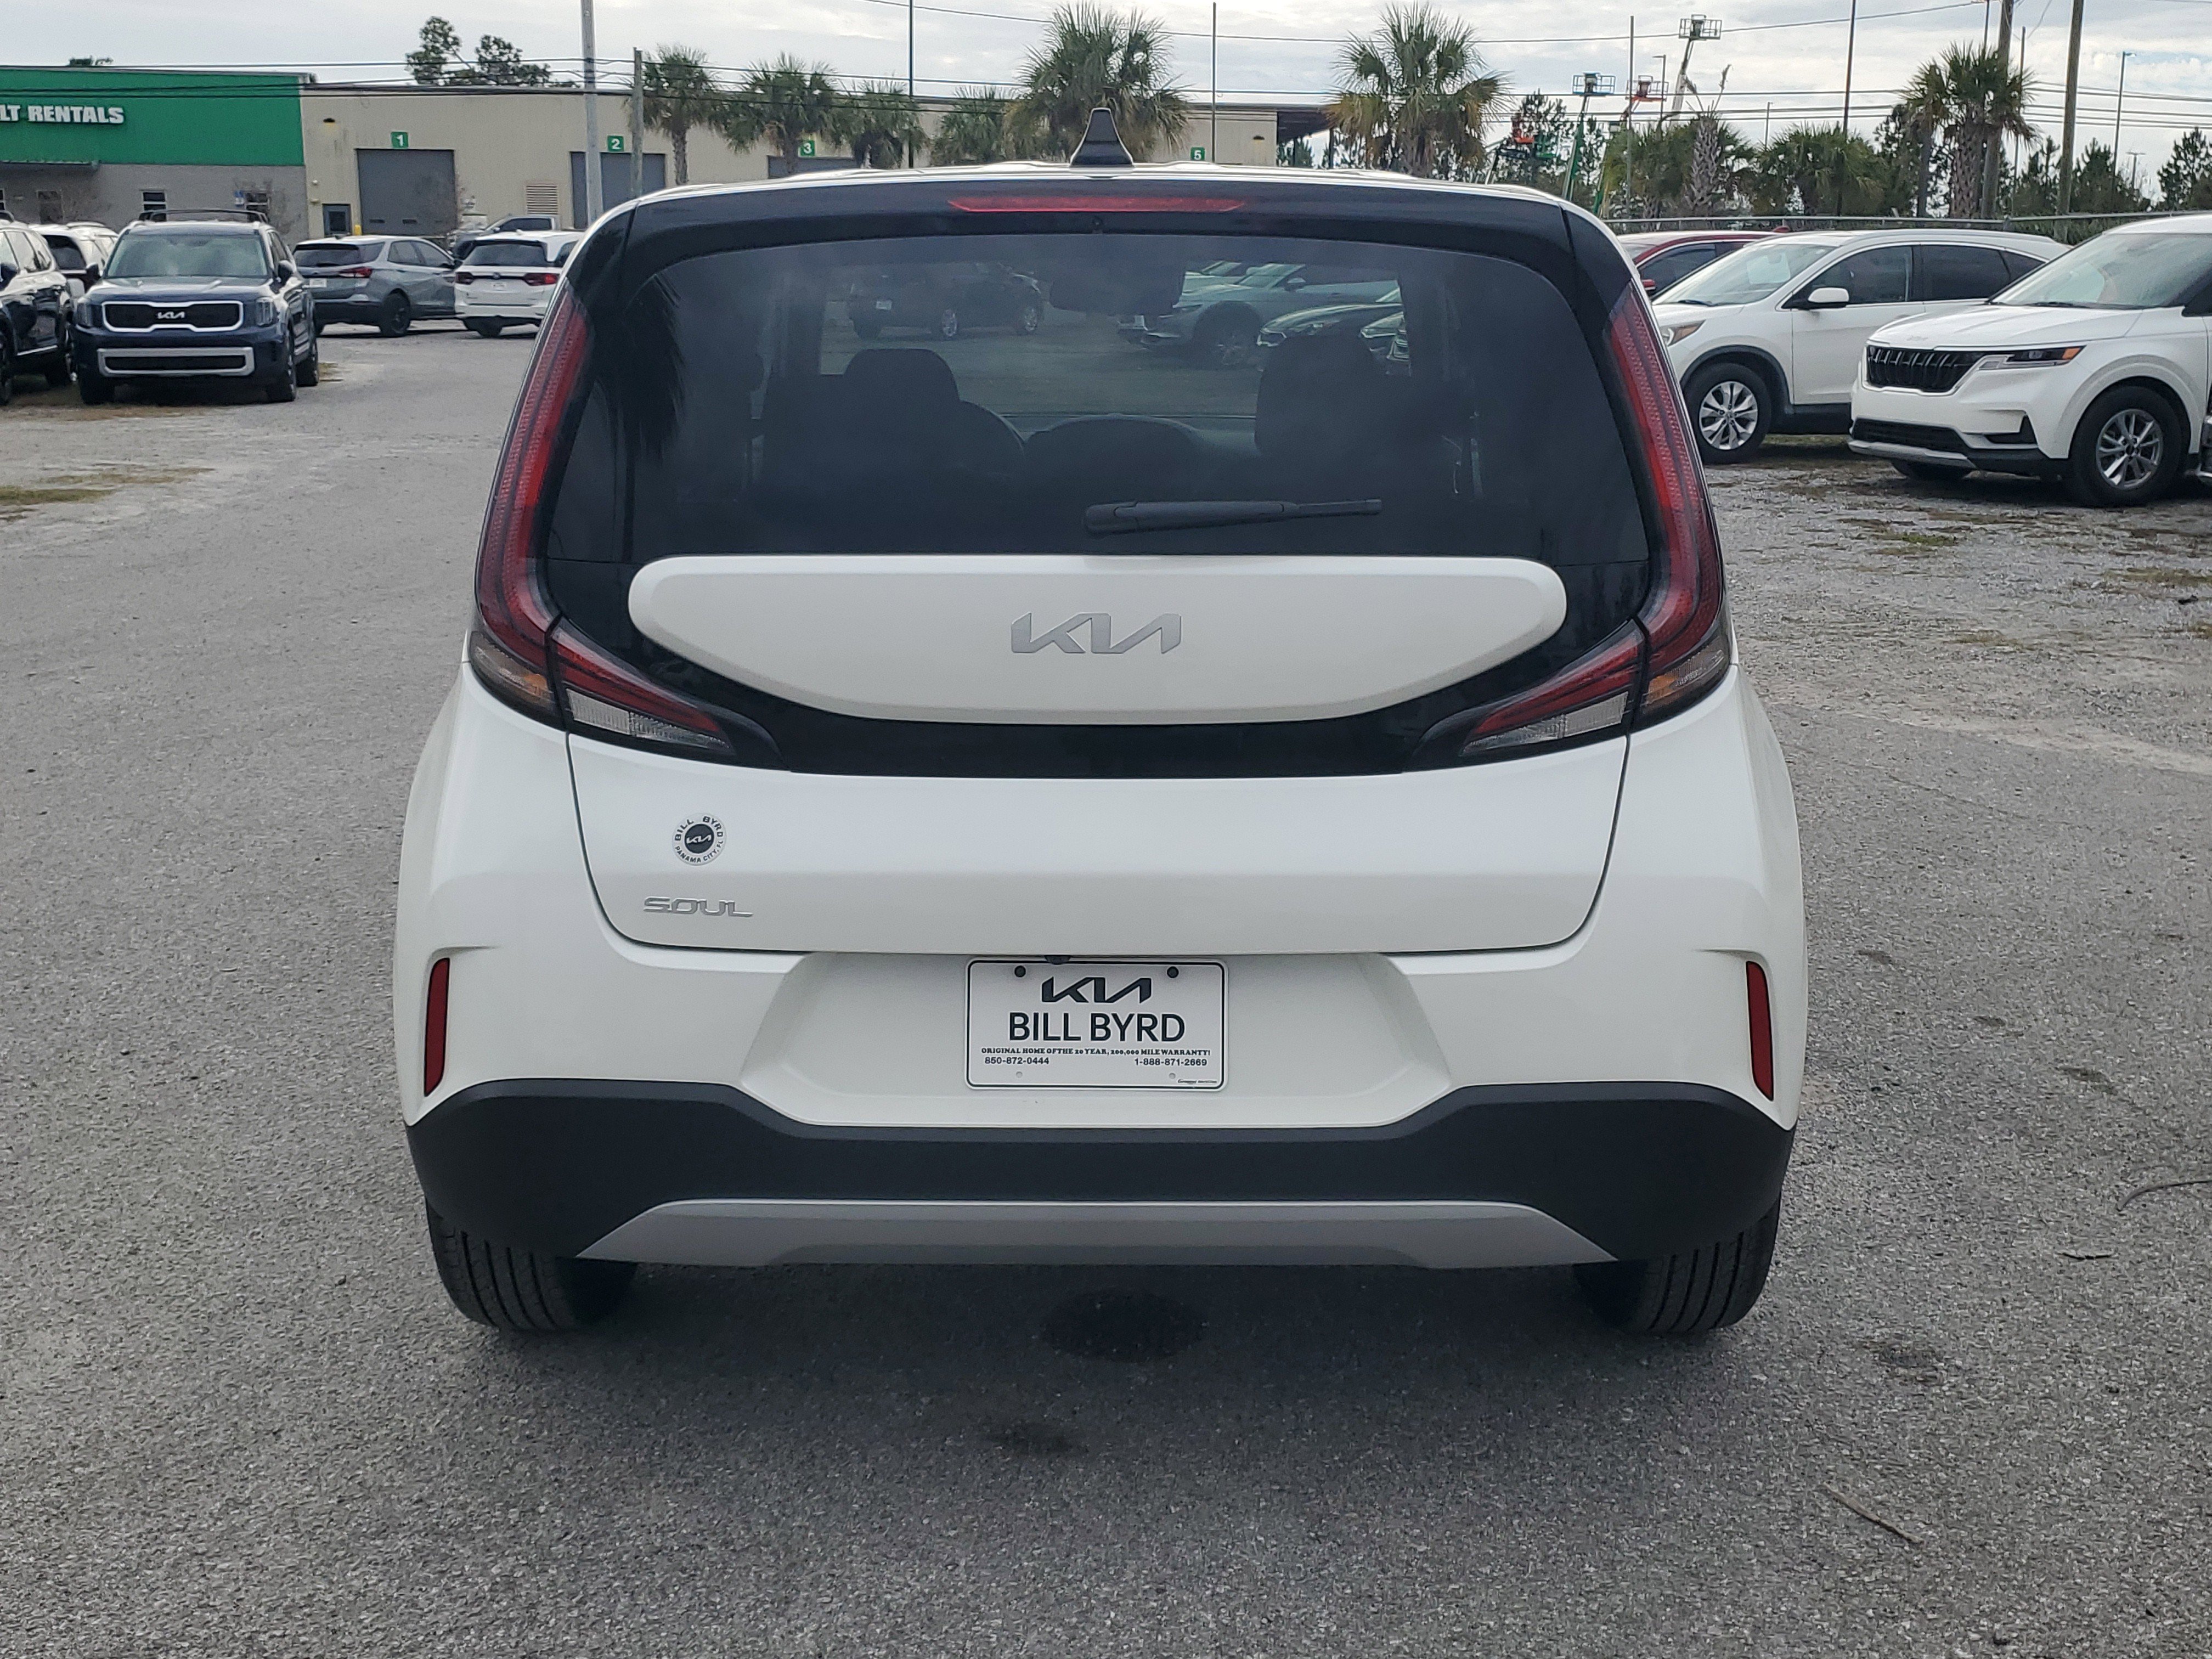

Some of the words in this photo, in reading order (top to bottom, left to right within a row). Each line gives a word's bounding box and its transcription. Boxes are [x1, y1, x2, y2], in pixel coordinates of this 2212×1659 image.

[28, 105, 124, 124] RENTALS
[396, 134, 404, 146] 1
[611, 138, 621, 149] 2
[803, 143, 812, 154] 3
[1194, 150, 1201, 160] 5
[1011, 612, 1181, 654] KIA
[675, 819, 694, 840] BILL
[702, 816, 723, 837] BYRD
[686, 834, 712, 844] KIA
[675, 846, 701, 862] PANAMA
[643, 896, 754, 917] SOUL
[1042, 977, 1151, 1003] KIA
[1009, 1012, 1081, 1041] BILL
[1091, 1013, 1185, 1041] BYRD
[1135, 1058, 1207, 1066] 1-888-871-2669
